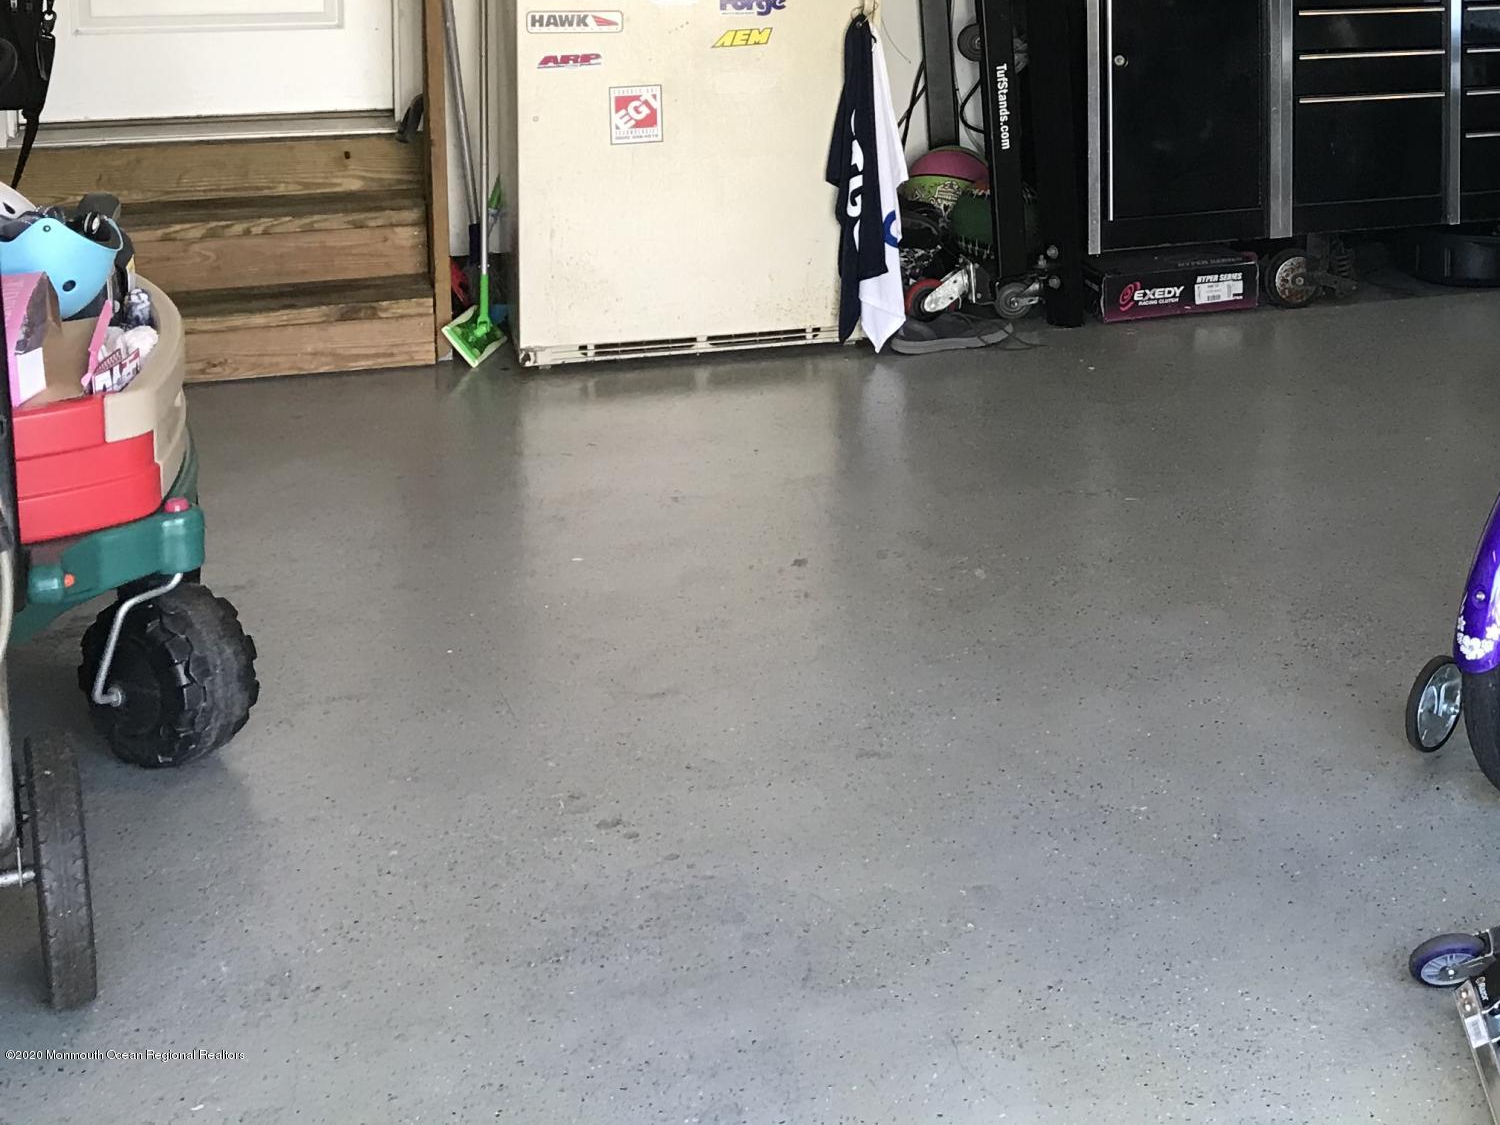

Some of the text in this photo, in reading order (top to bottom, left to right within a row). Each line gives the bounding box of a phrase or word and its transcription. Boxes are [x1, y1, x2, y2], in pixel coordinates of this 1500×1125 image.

[530, 14, 590, 27] HAWK
[712, 27, 772, 48] AEM
[539, 53, 602, 65] ARP
[995, 63, 1011, 150] TufStands.com
[1196, 273, 1243, 283] HYPER SERIES
[1134, 286, 1184, 301] EXEDY
